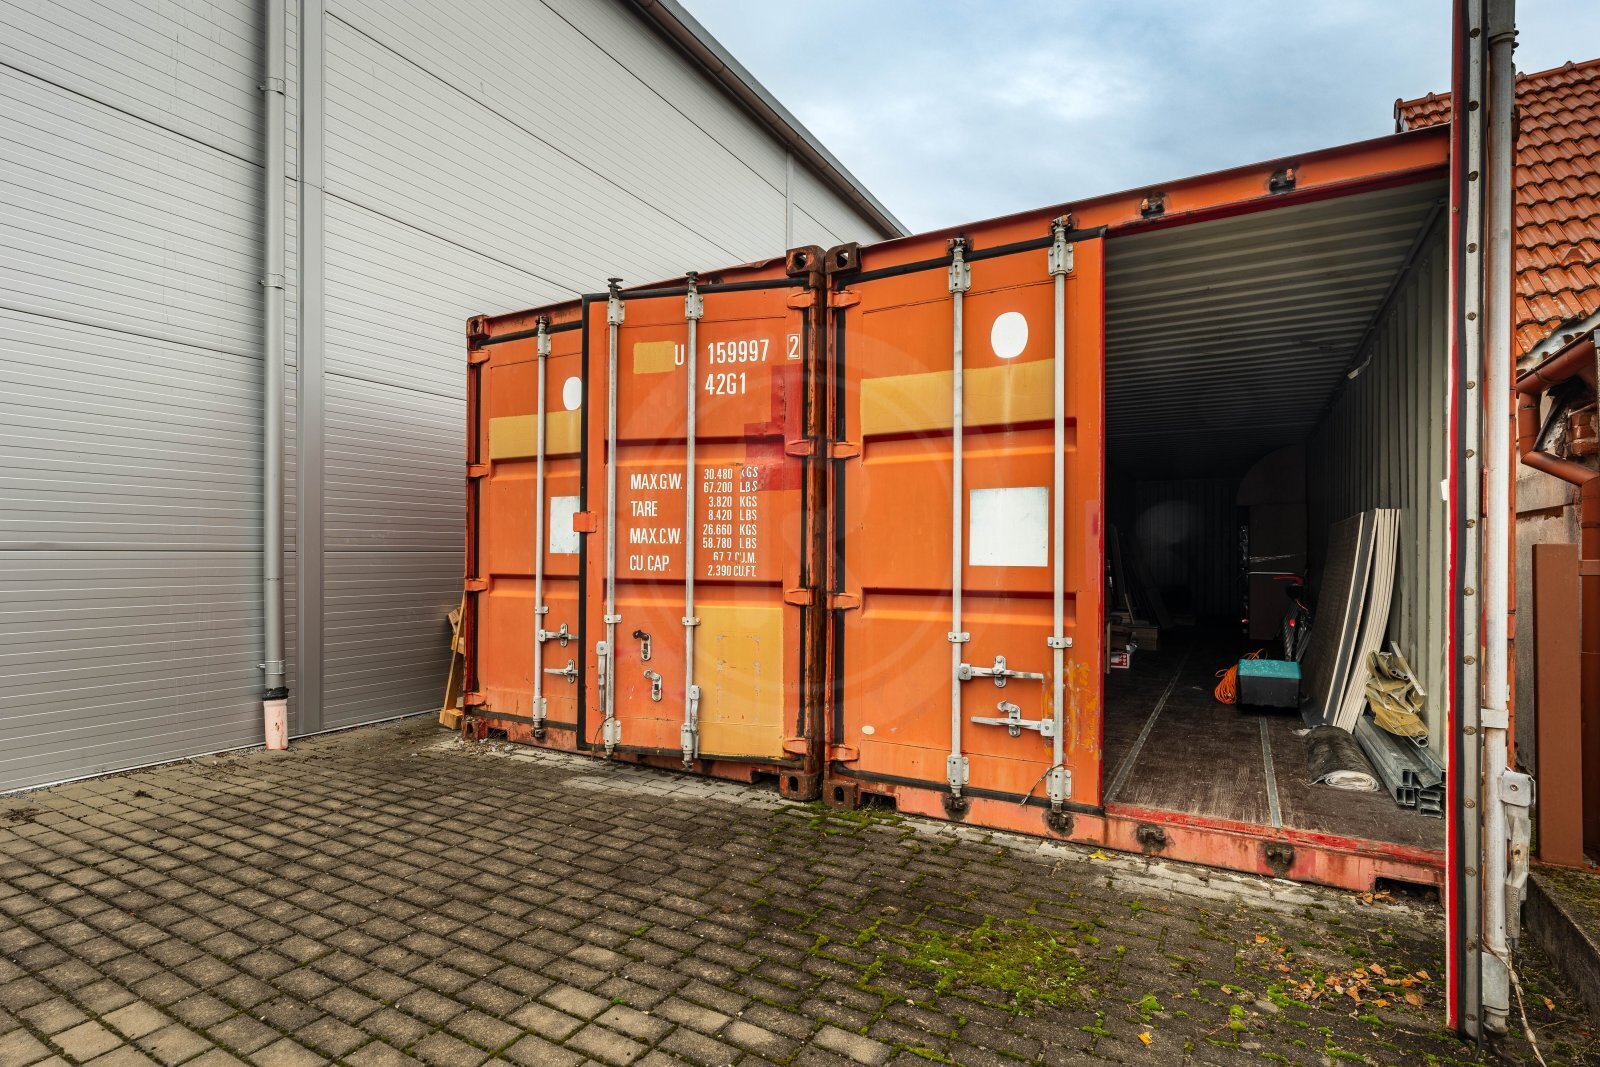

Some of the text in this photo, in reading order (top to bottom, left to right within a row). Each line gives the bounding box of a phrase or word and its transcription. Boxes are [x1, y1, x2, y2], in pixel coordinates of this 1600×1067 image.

[707, 338, 770, 365] 159997
[788, 335, 799, 358] 2
[704, 372, 746, 395] 42G1
[703, 468, 733, 480] 30.480
[703, 480, 758, 493] 67.200 LBS
[708, 495, 758, 508] 3.820 KGS
[630, 500, 658, 517] TARE
[708, 509, 758, 521] 8.420 LBS
[702, 523, 757, 536] 26.660 KGS
[702, 537, 757, 549] 58.780 LBS
[707, 564, 732, 577] 2.390
